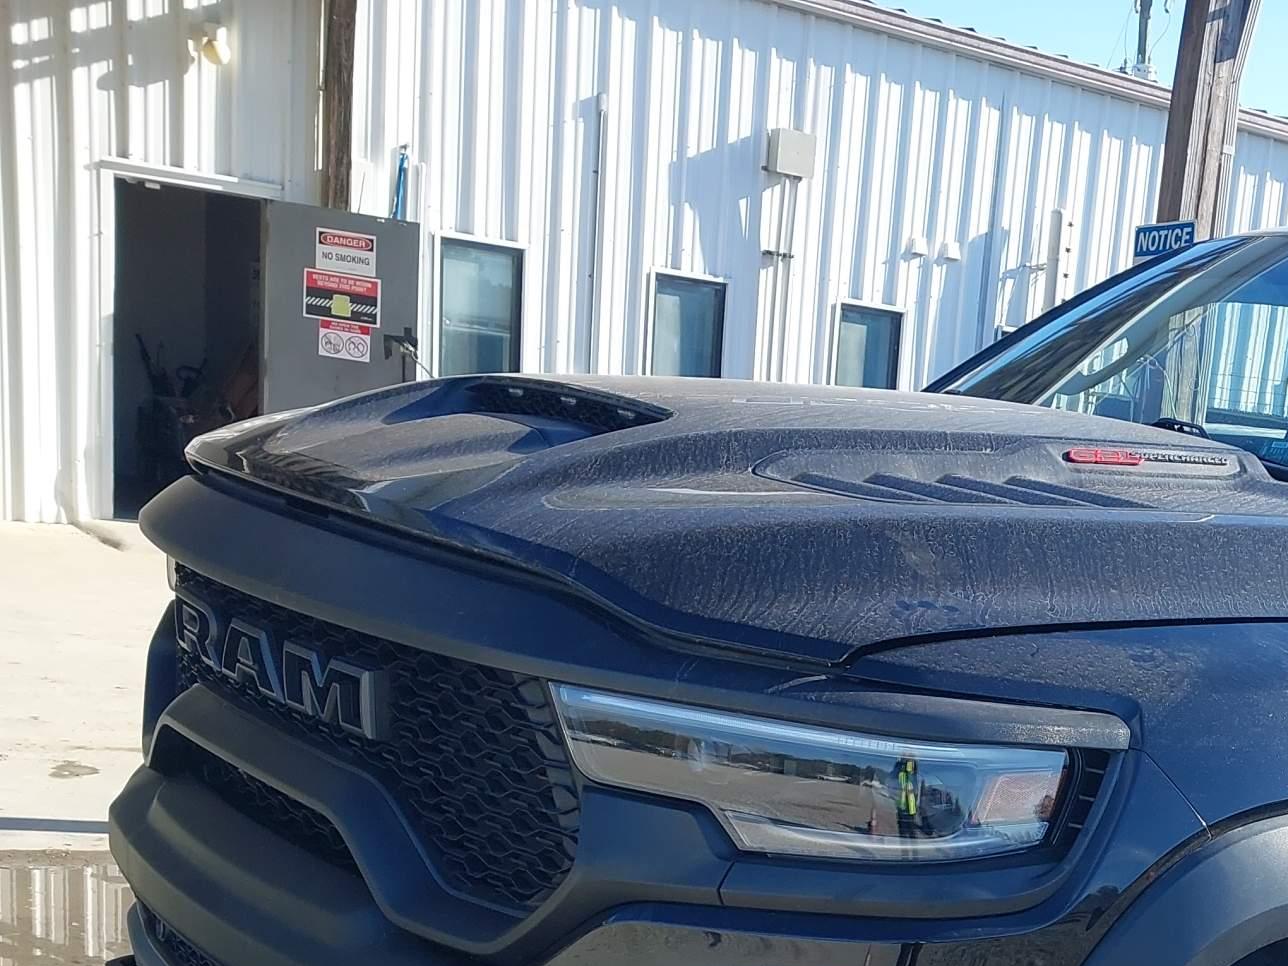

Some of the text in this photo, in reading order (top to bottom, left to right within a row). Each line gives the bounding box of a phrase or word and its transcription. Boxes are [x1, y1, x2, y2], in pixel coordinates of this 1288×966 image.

[326, 235, 366, 248] DANGER
[1137, 227, 1192, 252] NOTICE
[321, 250, 370, 266] NO SMOKING
[174, 592, 374, 740] RAM
